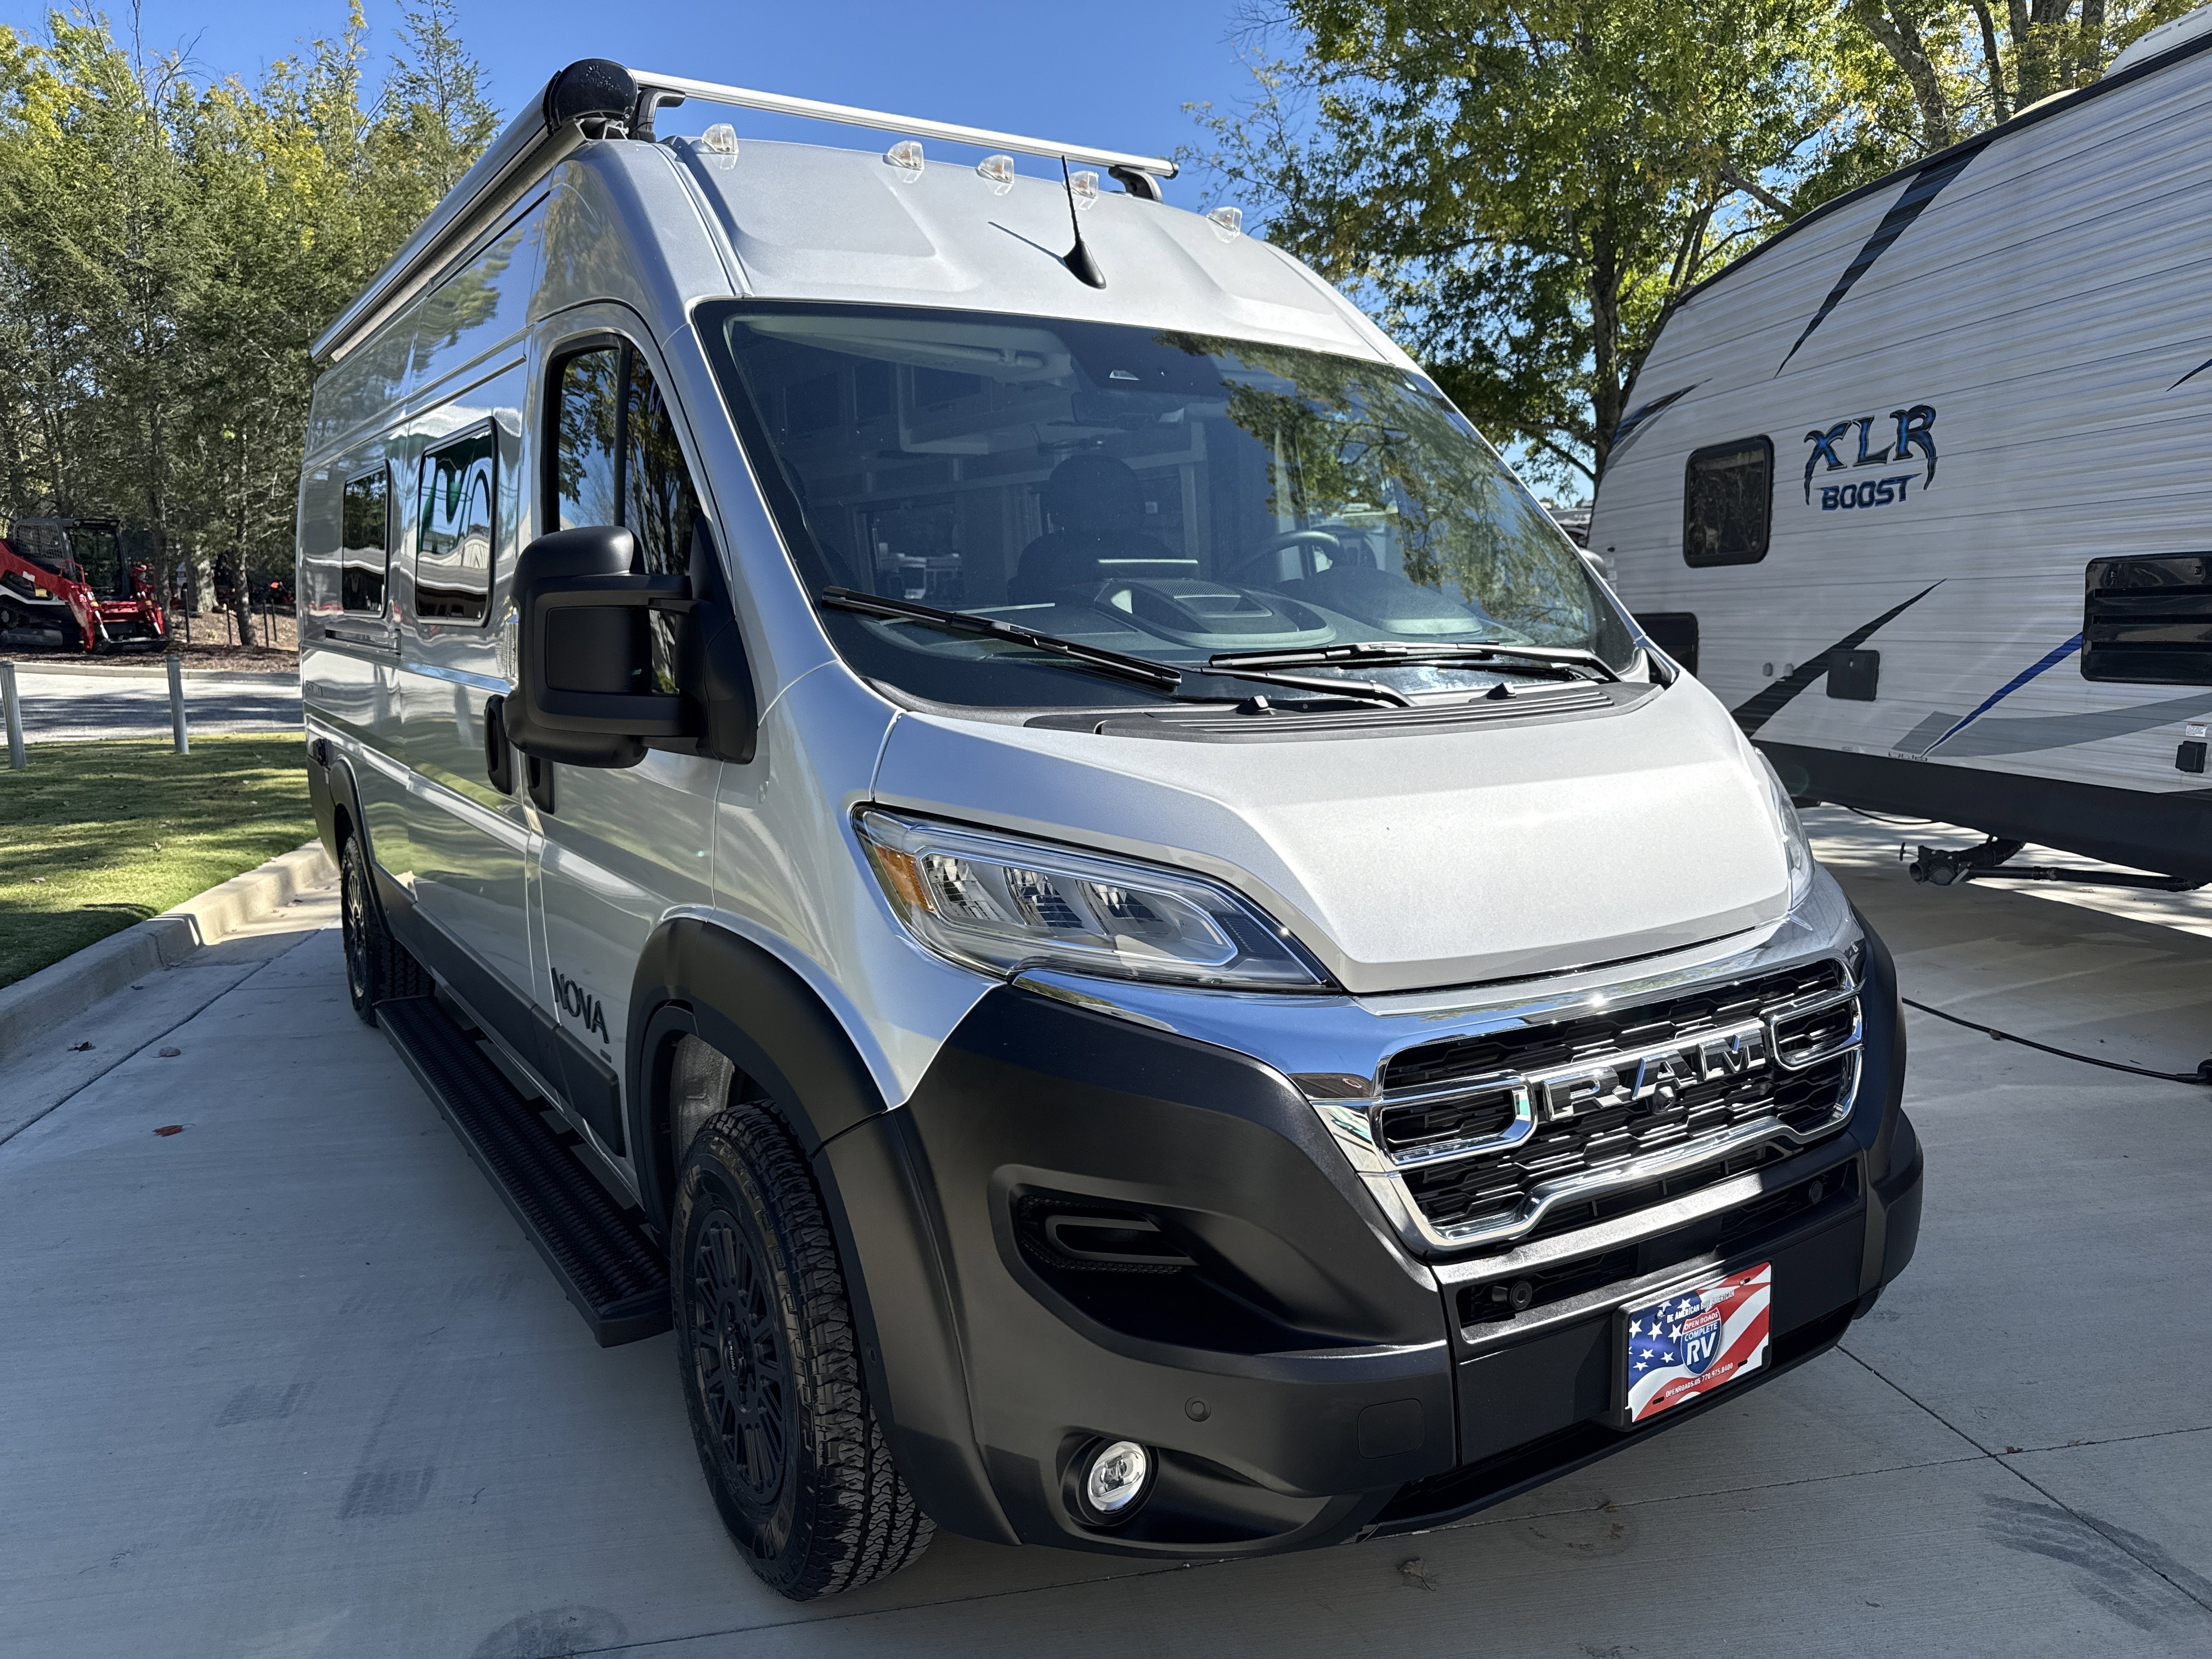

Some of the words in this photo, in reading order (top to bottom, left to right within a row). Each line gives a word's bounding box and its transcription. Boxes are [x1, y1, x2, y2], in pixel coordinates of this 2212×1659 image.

[1804, 403, 1938, 505] XLR
[1814, 473, 1922, 511] BOOST
[551, 967, 610, 1044] NOVA
[1542, 1029, 1765, 1121] RAM
[1667, 1314, 1674, 1323] BE
[1675, 1304, 1700, 1321] AMERICAN
[1701, 1299, 1711, 1310] BUY
[1711, 1290, 1735, 1306] AMERICAN
[1684, 1320, 1699, 1330] OPEN
[1700, 1311, 1718, 1324] ROADS
[1684, 1322, 1718, 1342] COMPLETE
[1686, 1331, 1717, 1366] RV
[1666, 1378, 1701, 1398] OPENROADS.US
[1702, 1362, 1733, 1382] 770.975.8400
